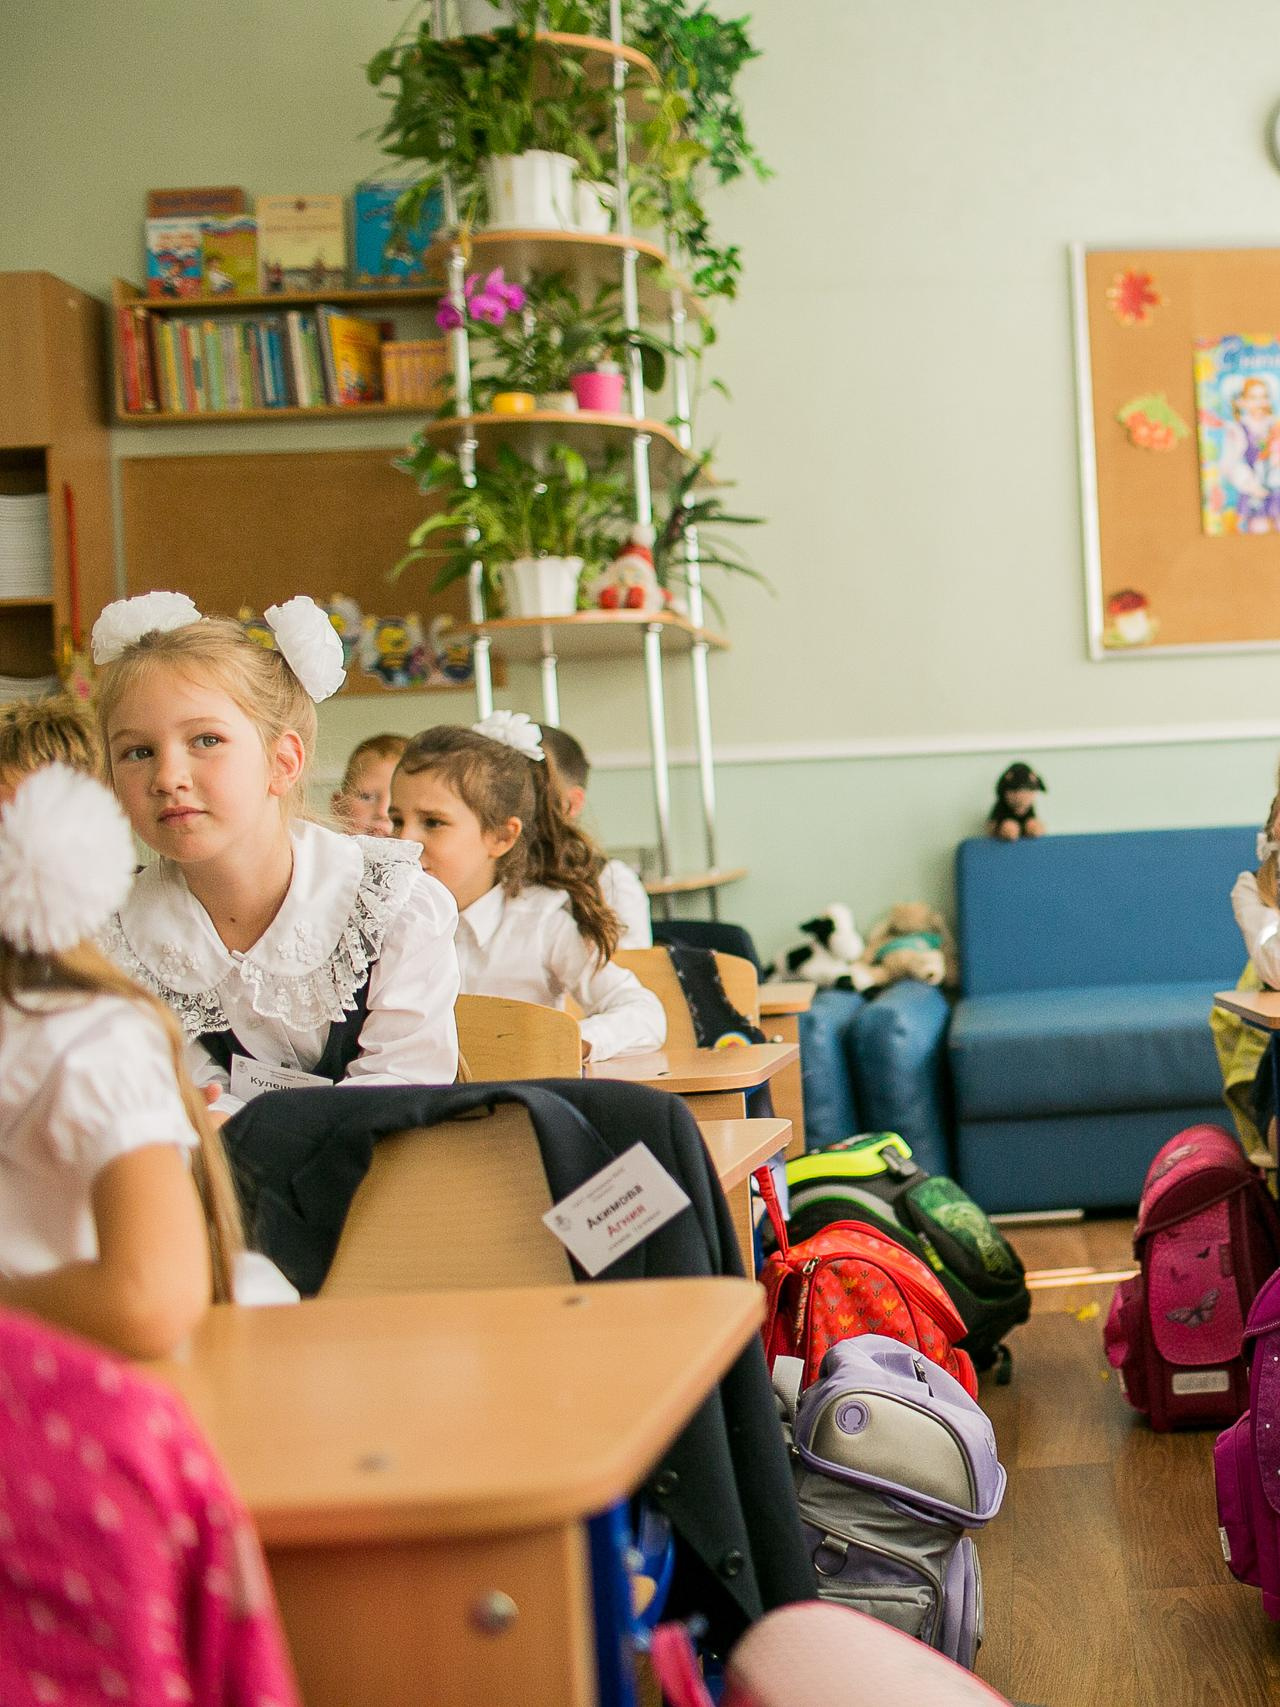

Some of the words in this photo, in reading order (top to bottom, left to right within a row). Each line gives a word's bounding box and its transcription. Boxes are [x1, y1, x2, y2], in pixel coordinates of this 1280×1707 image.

[250, 1076, 297, 1092] Кулеш
[587, 1184, 643, 1229] Акимова
[608, 1204, 646, 1237] Агния
